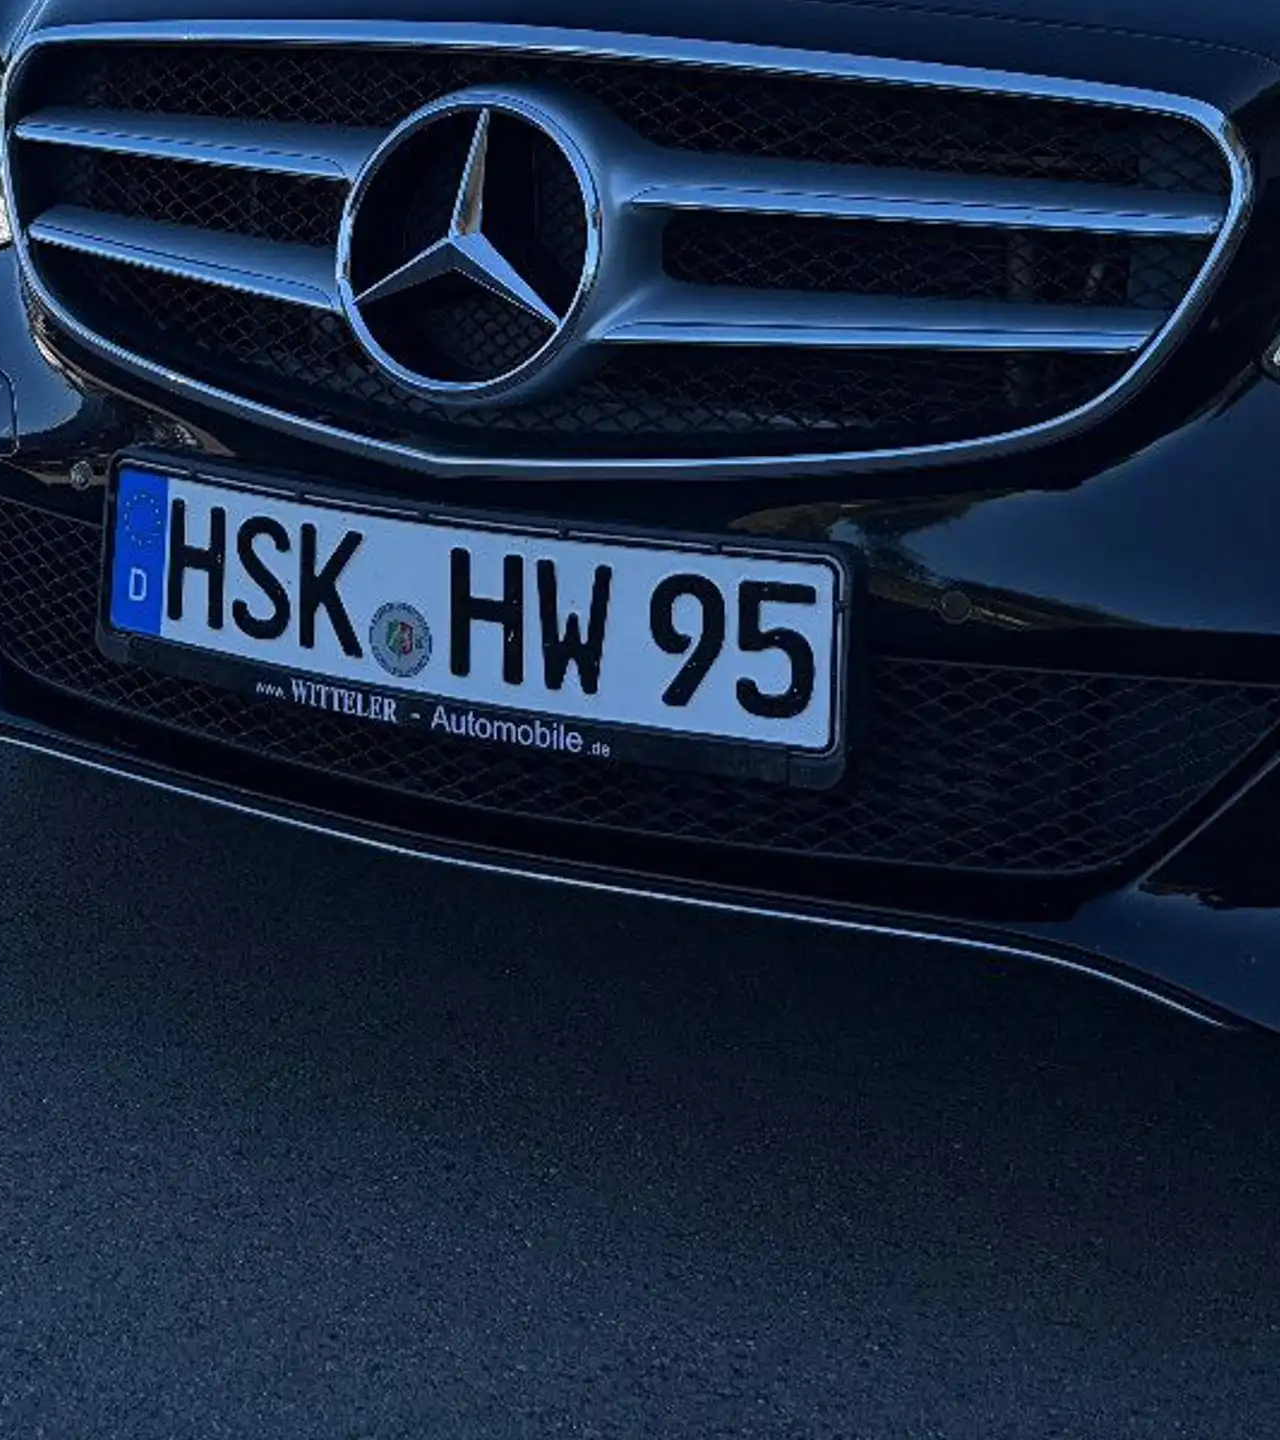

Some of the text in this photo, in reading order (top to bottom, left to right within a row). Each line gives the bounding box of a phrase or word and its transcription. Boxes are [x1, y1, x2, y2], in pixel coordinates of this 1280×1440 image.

[129, 567, 147, 601] D
[167, 499, 363, 658] HSK
[450, 547, 612, 694] HW
[649, 573, 817, 718] 95
[290, 677, 398, 724] WITTELER
[430, 704, 583, 754] Automobile
